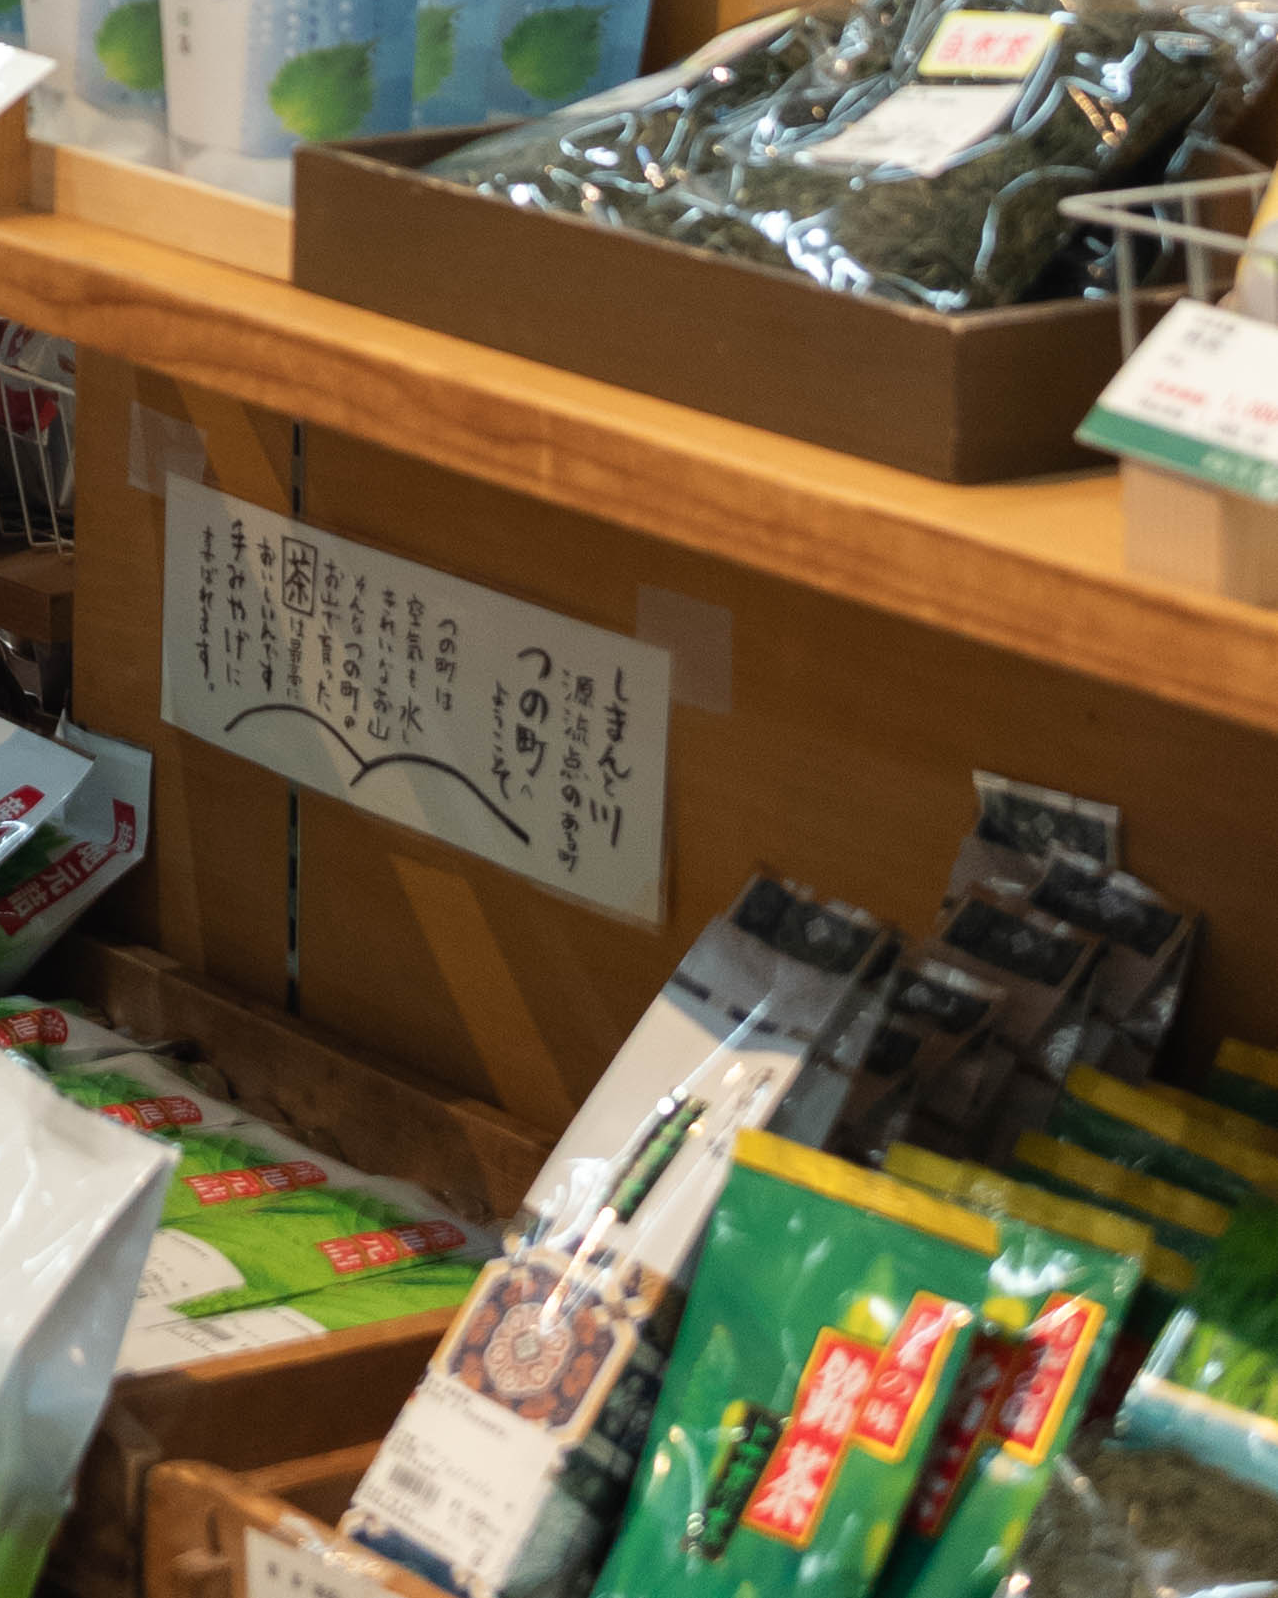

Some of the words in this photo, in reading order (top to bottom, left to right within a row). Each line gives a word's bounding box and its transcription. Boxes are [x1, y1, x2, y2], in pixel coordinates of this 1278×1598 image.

[256, 536, 277, 693] おいしいんです
[434, 618, 458, 712] つの町は
[515, 646, 552, 800] つの町へ
[589, 666, 632, 848] しまんと川
